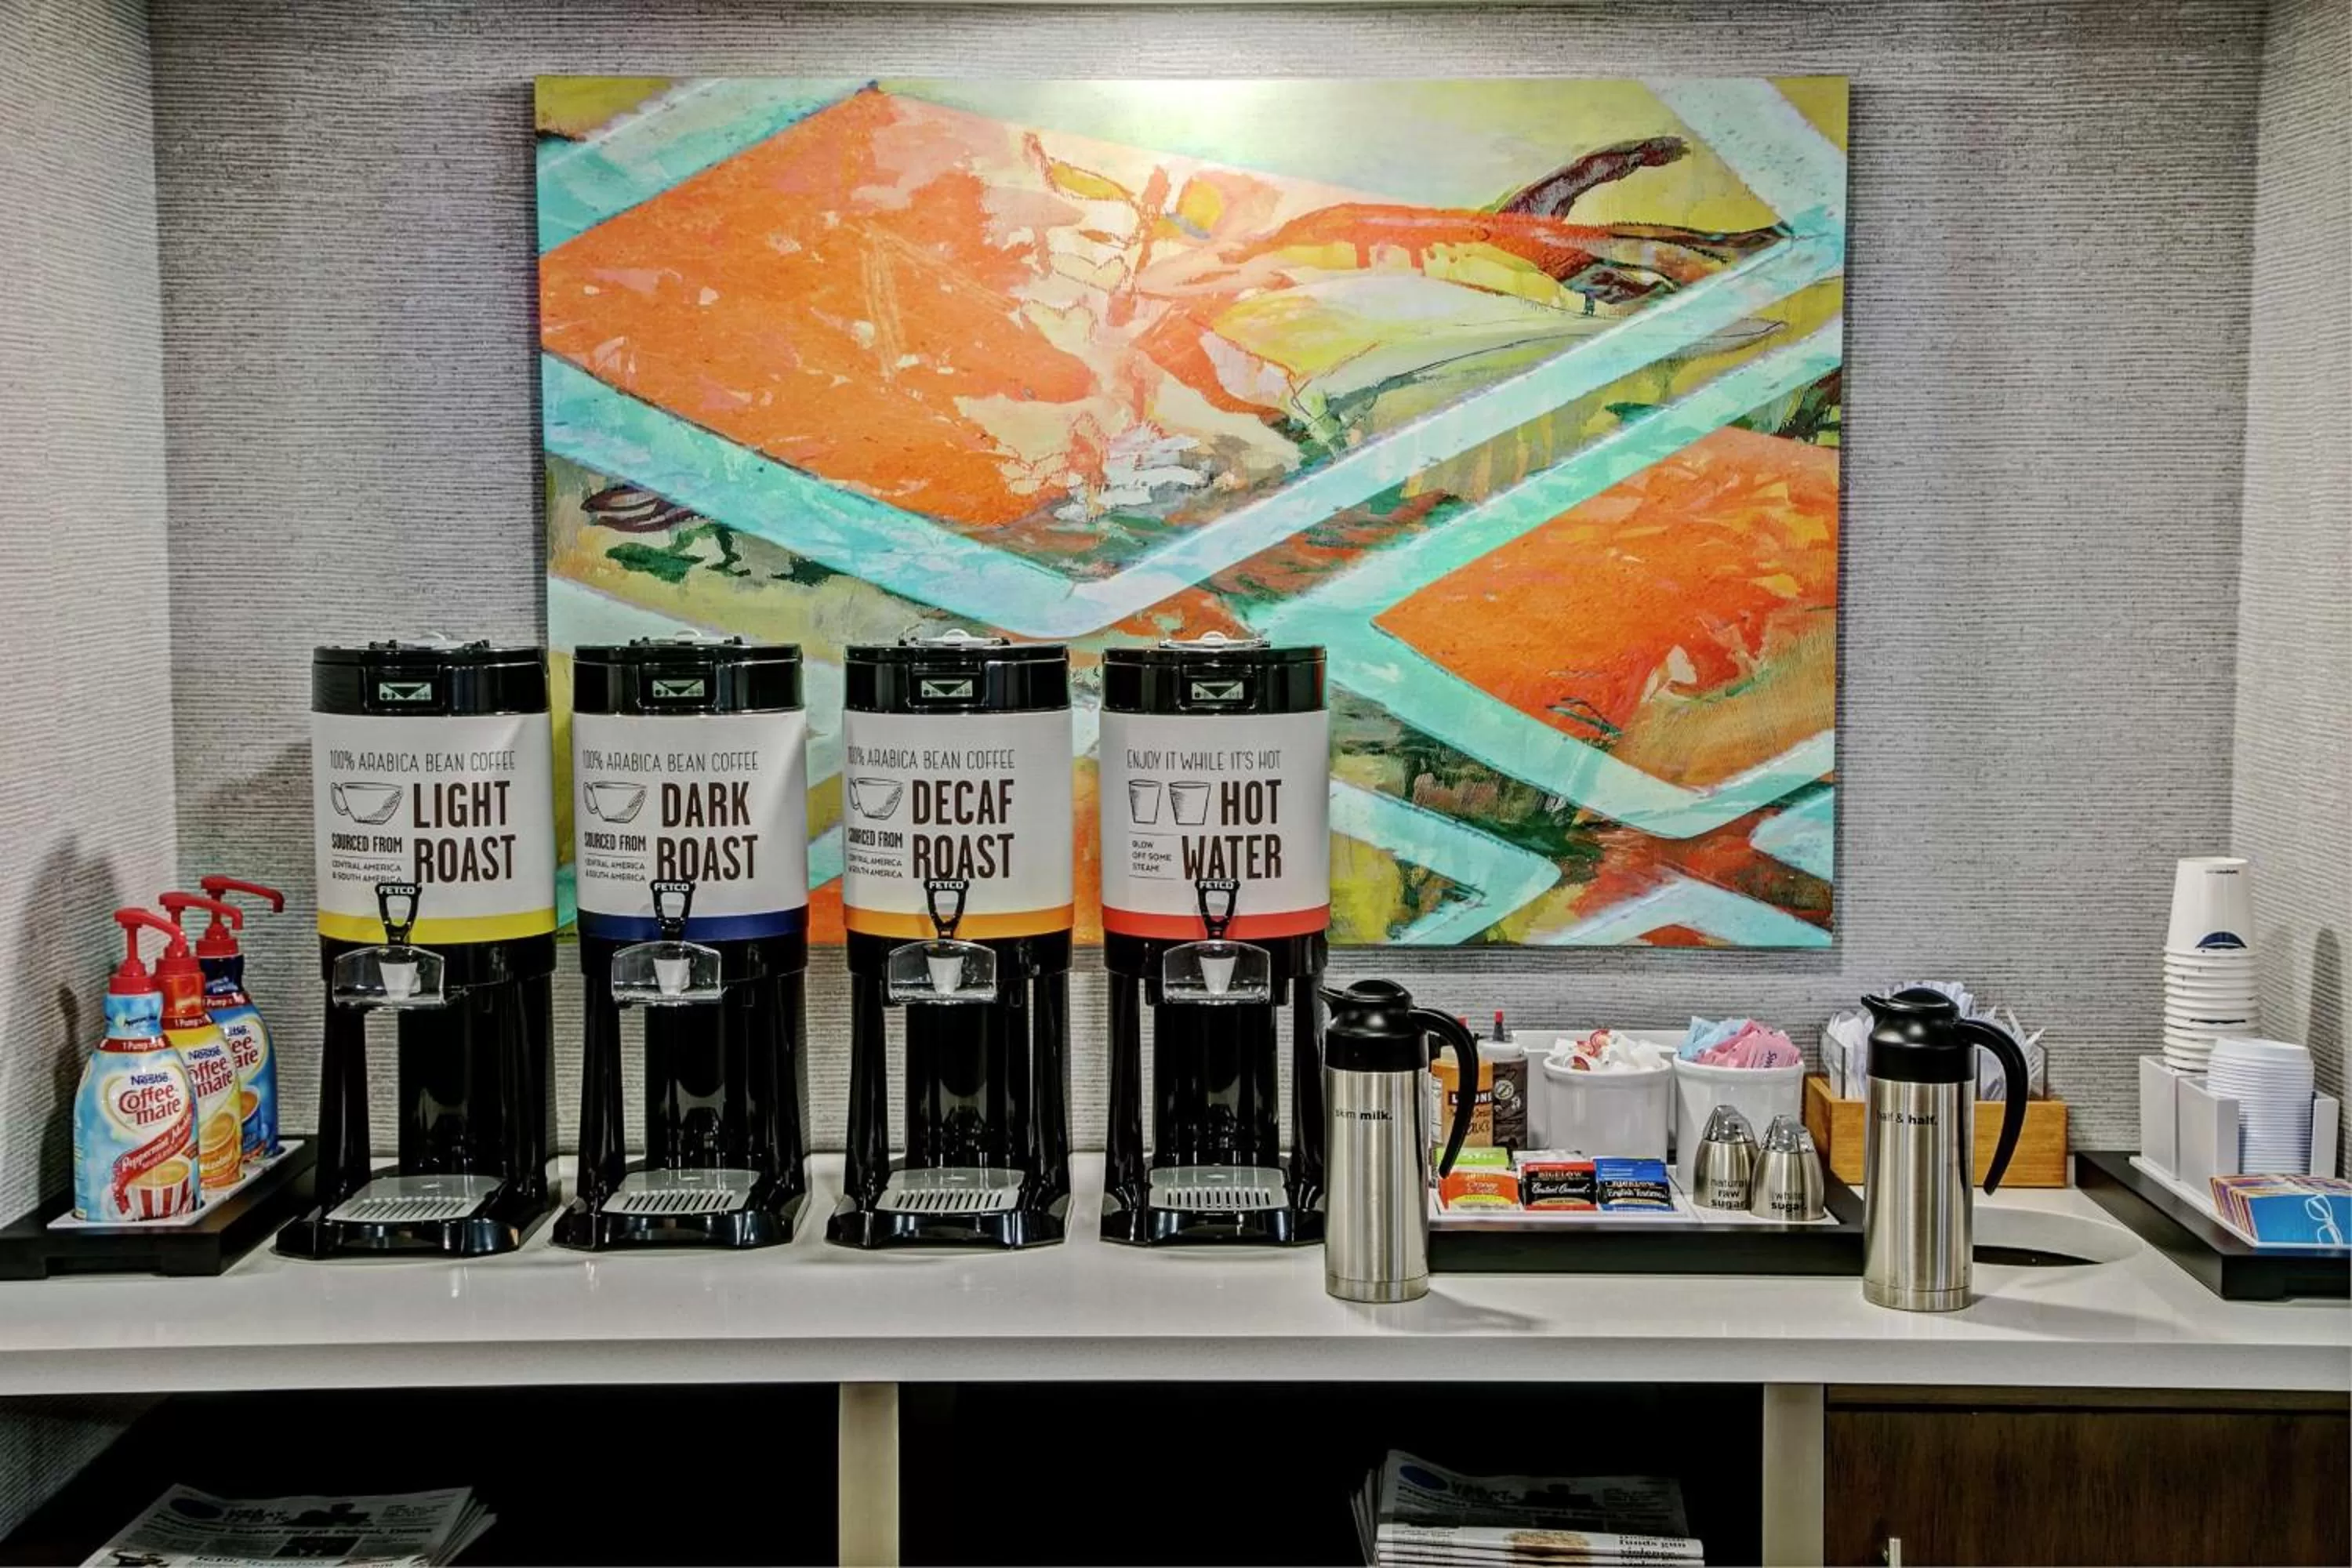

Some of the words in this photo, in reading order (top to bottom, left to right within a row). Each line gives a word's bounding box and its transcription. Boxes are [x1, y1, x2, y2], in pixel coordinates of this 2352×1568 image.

[329, 750, 355, 770] 100%
[358, 752, 419, 772] ARABICA
[426, 753, 465, 772] BEAN
[471, 750, 516, 771] COFFEE
[583, 750, 603, 770] 100%
[607, 752, 662, 772] ARABICA
[668, 753, 705, 772] BEAN
[712, 750, 759, 772] COFFEE
[867, 749, 918, 770] ARABICA
[924, 750, 960, 770] BEAN
[967, 750, 1015, 770] COFFEE
[1127, 749, 1162, 770] ENJOY
[1166, 751, 1176, 770] IT
[1181, 752, 1224, 771] WHILE
[1231, 751, 1254, 771] IT'S
[1258, 750, 1282, 769] HOT
[413, 780, 510, 828] LIGHT
[661, 781, 751, 828] DARK
[912, 779, 1014, 826] DECAF
[1221, 779, 1282, 826] HOT
[332, 833, 369, 852] SOURCED
[372, 837, 402, 853] FROM
[584, 831, 615, 851] SOURCED
[619, 835, 646, 851] FROM
[878, 831, 903, 849] FROM
[414, 834, 516, 884] ROAST
[656, 834, 758, 881] ROAST
[870, 858, 903, 866] AMERICA
[913, 833, 1014, 879] ROAST
[1148, 852, 1172, 862] SOME
[1181, 834, 1282, 880] WATER
[362, 862, 401, 872] AMERICA
[611, 872, 645, 881] AMERICA
[869, 869, 904, 878] AMERICA
[338, 872, 361, 880] SOUTH
[363, 874, 402, 884] AMERICA
[654, 883, 690, 892] FETCO
[929, 881, 964, 890] FETCO
[1199, 881, 1234, 890] FETCO
[379, 886, 416, 895] FETCO
[188, 1045, 221, 1060] Nestlé
[234, 1049, 258, 1068] ate
[130, 1072, 169, 1085] Nestlé
[188, 1056, 227, 1082] offee
[196, 1069, 233, 1098] mate
[118, 1084, 174, 1115] Coffee
[136, 1098, 181, 1125] mate
[1335, 1106, 1356, 1120] skm
[1360, 1109, 1393, 1120] milk.
[1896, 1112, 1904, 1123] &
[1908, 1114, 1939, 1127] half.
[1710, 1178, 1748, 1188] natural
